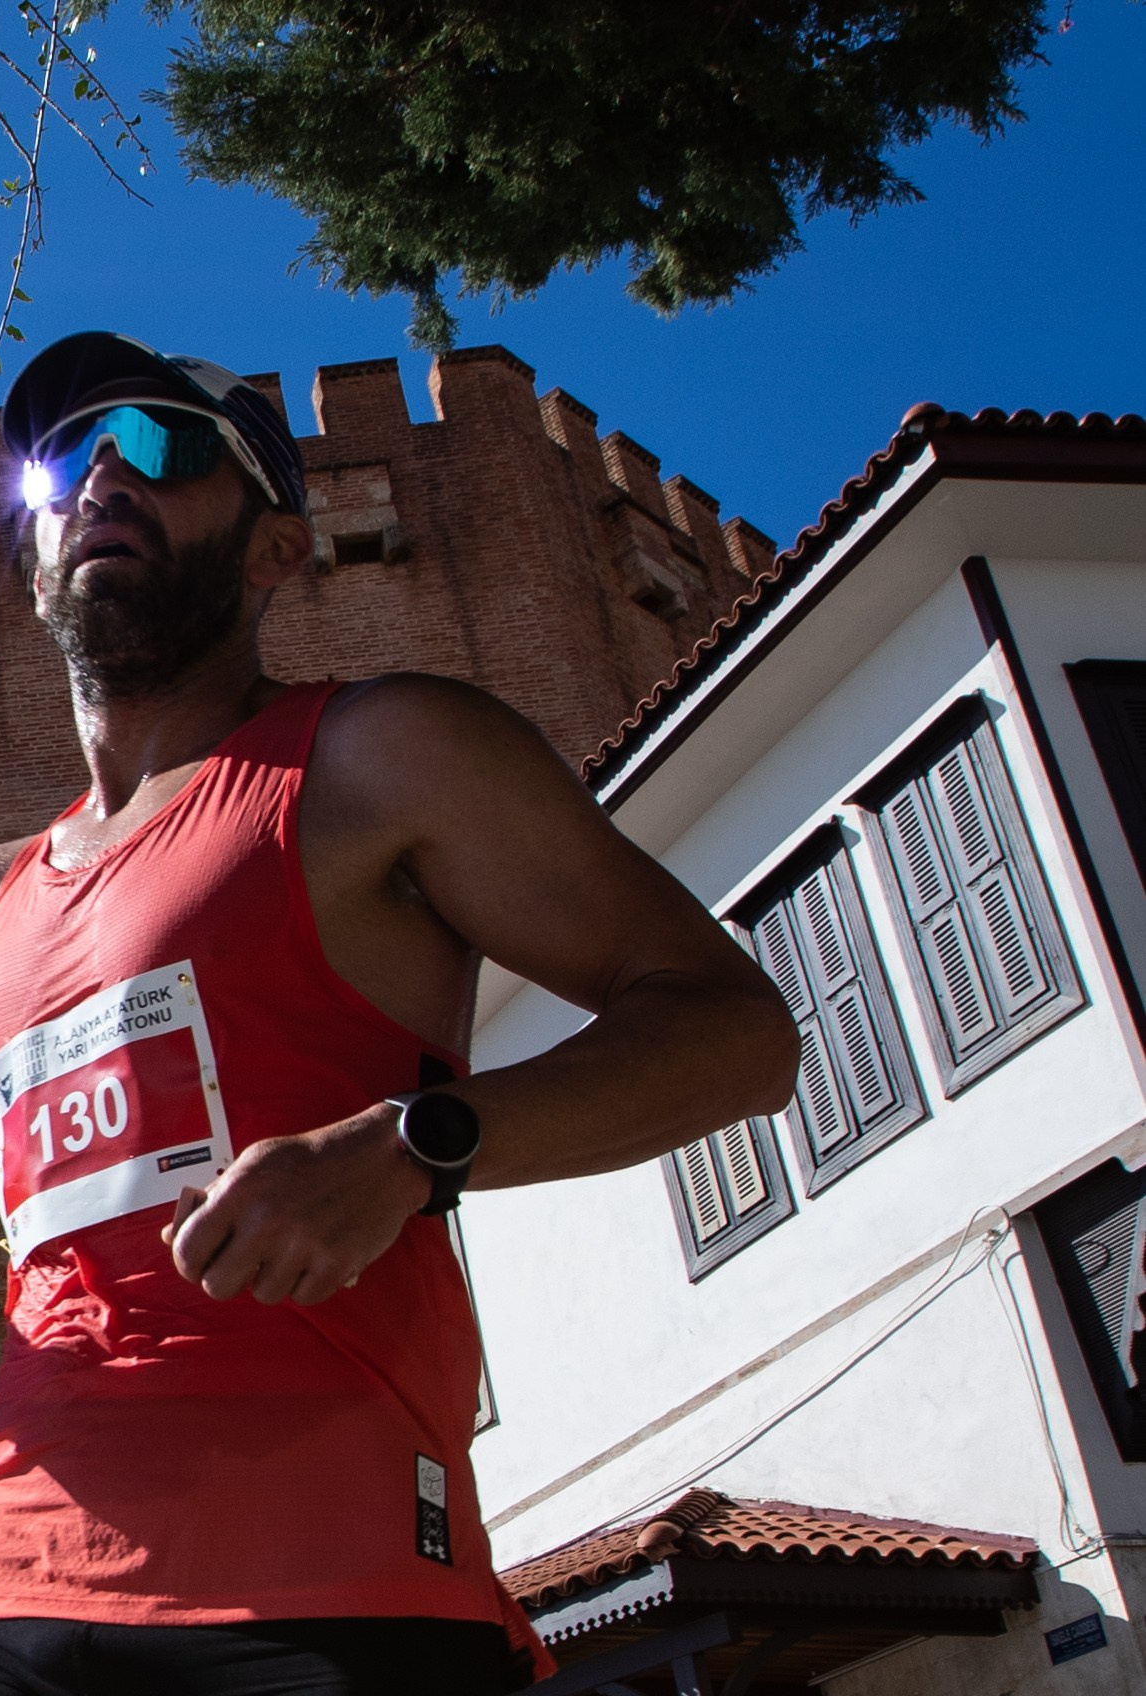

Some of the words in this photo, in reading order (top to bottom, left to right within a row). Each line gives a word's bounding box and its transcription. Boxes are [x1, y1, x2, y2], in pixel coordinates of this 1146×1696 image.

[104, 986, 173, 1020] ATATÜRK
[58, 1041, 89, 1064] YARI
[90, 1007, 172, 1049] MARATONU
[29, 1075, 129, 1164] 130
